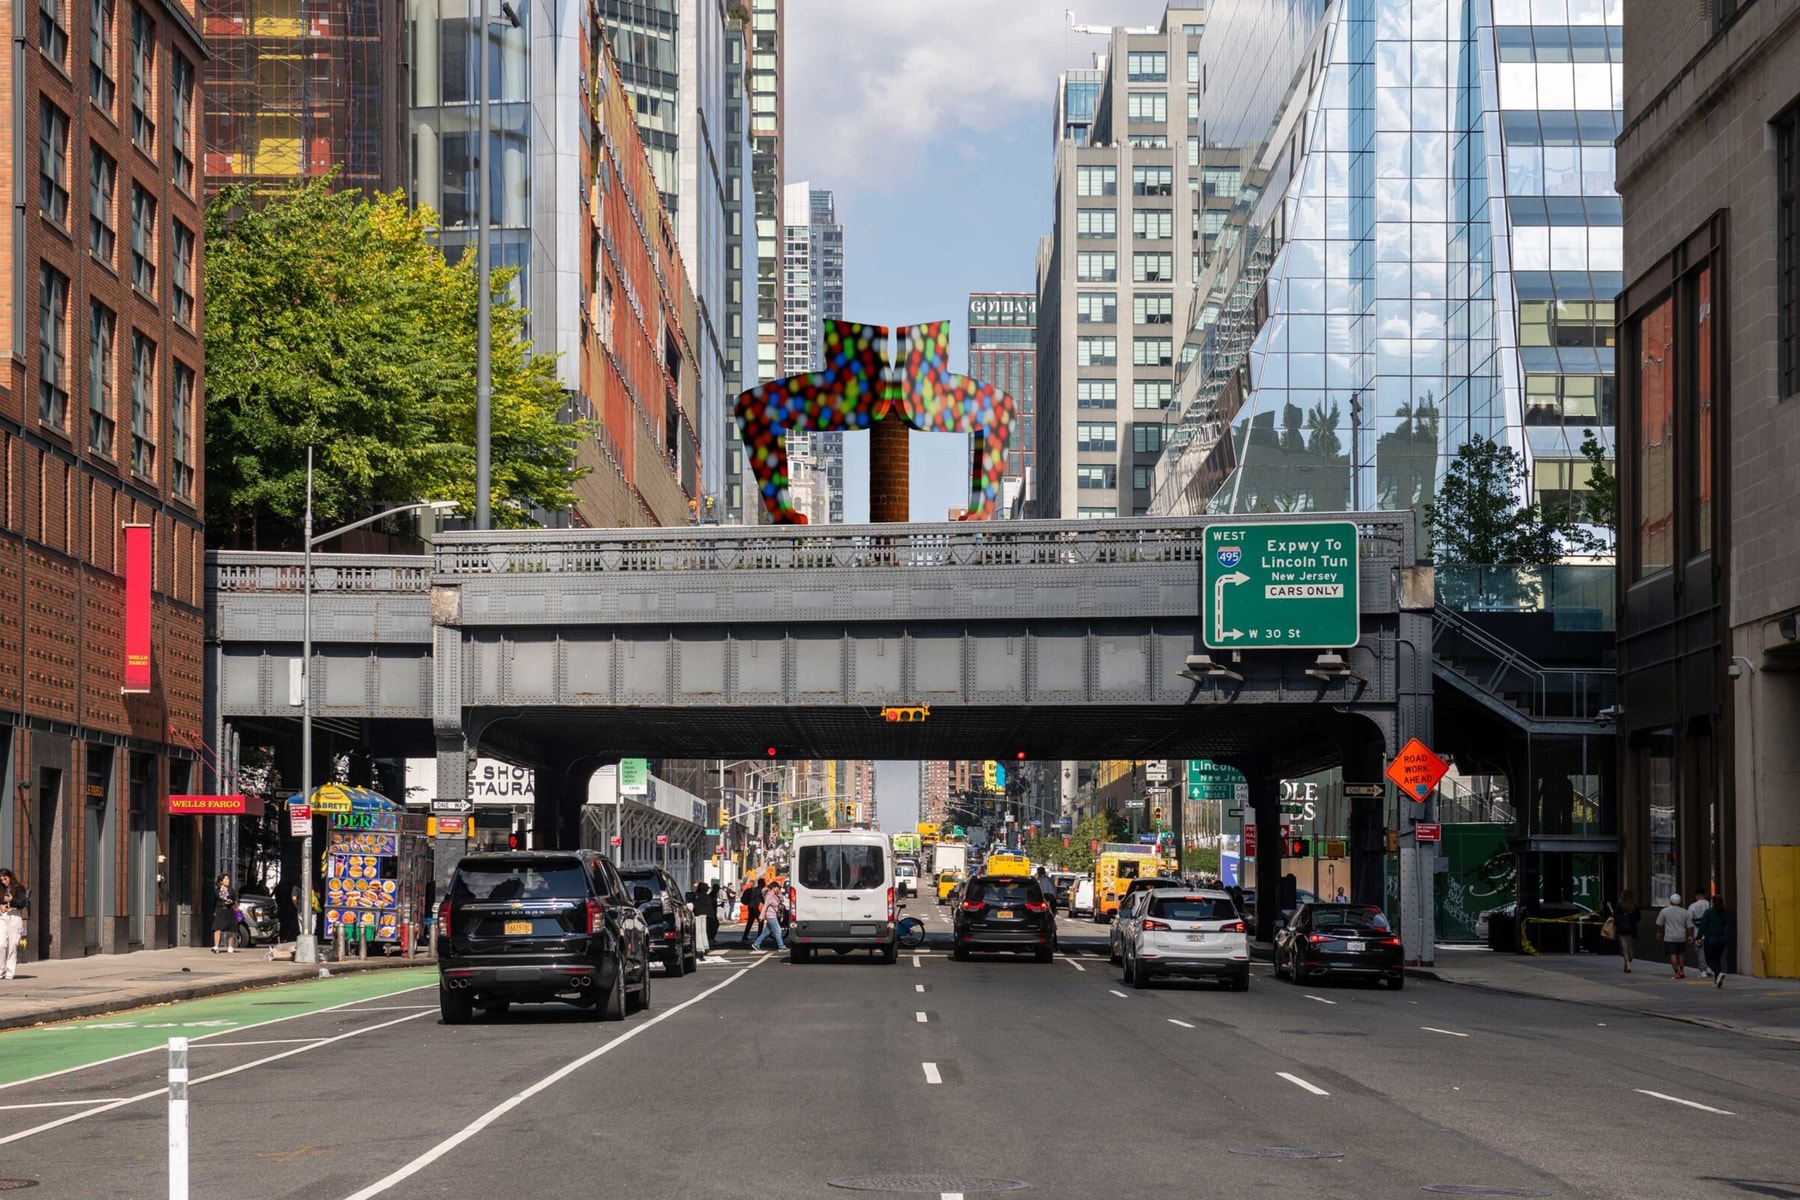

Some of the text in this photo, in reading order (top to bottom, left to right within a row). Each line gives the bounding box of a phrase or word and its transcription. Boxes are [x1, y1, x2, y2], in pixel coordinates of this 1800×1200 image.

[971, 301, 1036, 313] GOTHAM
[1213, 531, 1246, 541] WEST
[1267, 538, 1342, 554] Expwy To
[1219, 552, 1239, 562] 495
[1261, 555, 1348, 568] Lincoln Tun
[1271, 571, 1338, 582] New Jersey
[1270, 586, 1339, 596] CARS ONLY
[1248, 628, 1301, 639] W 30 St
[1404, 755, 1427, 763] ROAD
[1404, 765, 1428, 773] WORK
[1404, 775, 1432, 784] AHEAD
